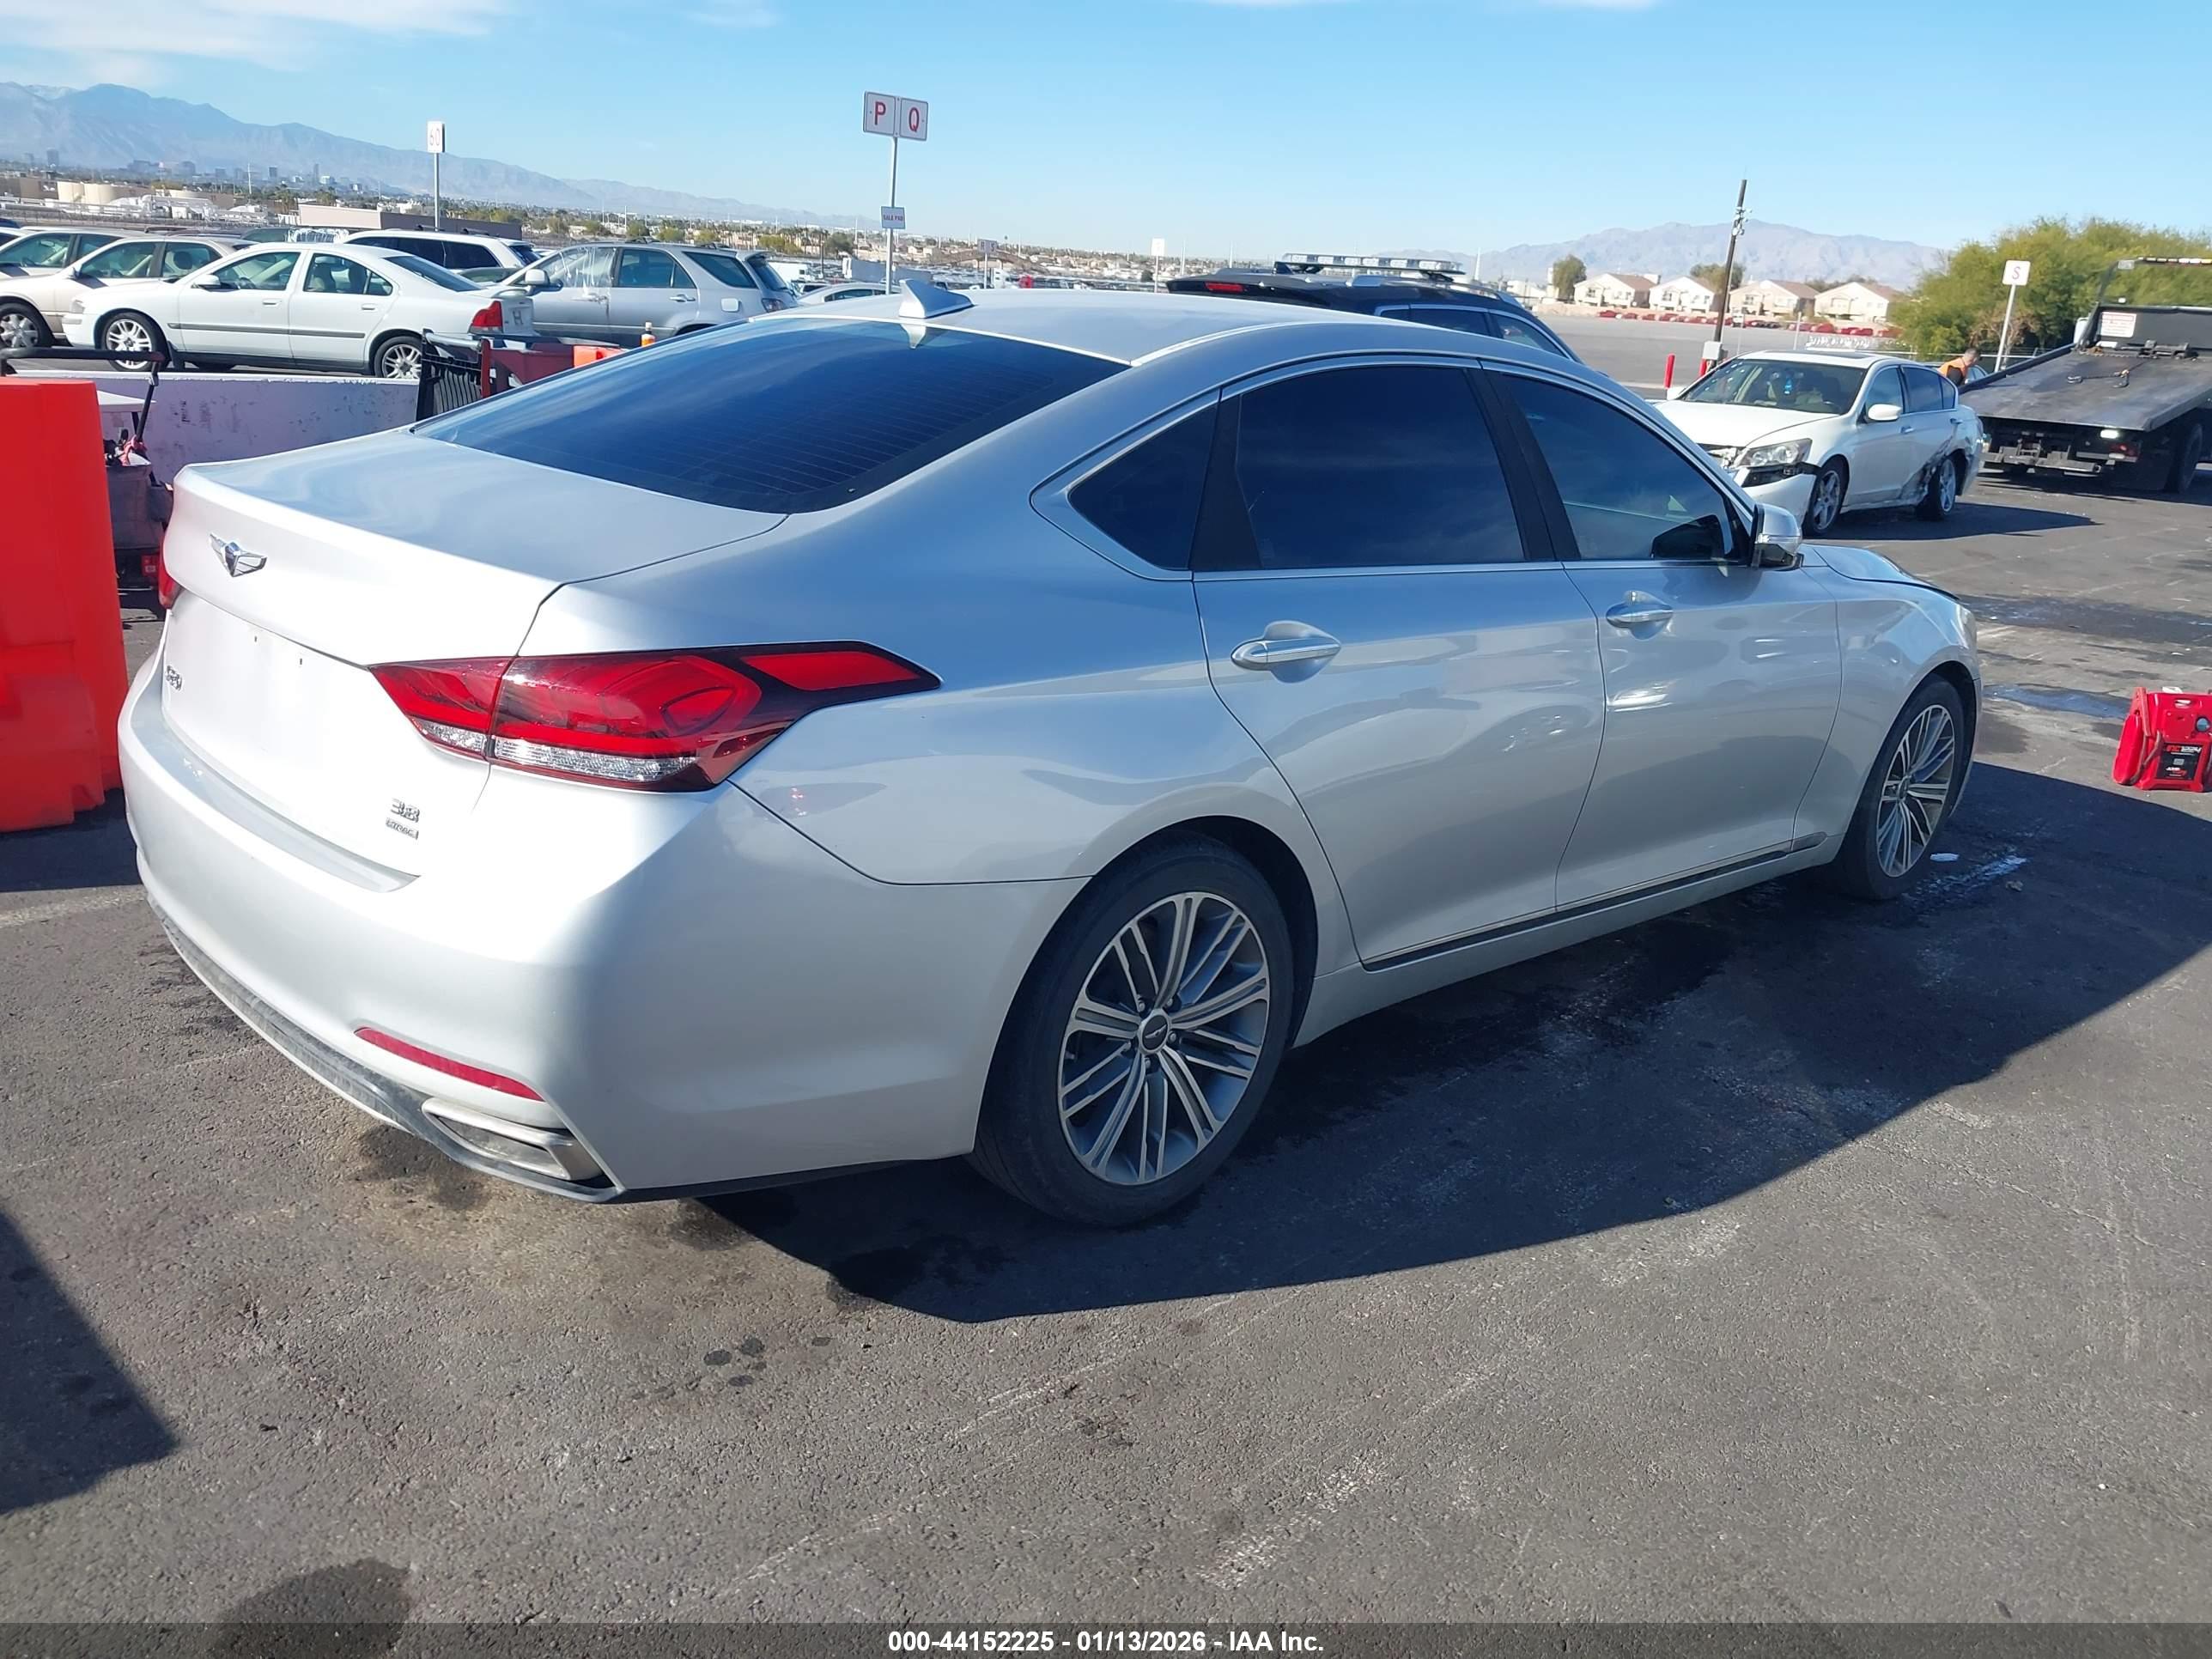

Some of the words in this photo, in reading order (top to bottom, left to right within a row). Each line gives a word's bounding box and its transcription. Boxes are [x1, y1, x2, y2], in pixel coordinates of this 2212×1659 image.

[874, 101, 886, 125] P
[908, 106, 920, 132] Q
[429, 128, 441, 146] 60
[2012, 266, 2021, 280] S
